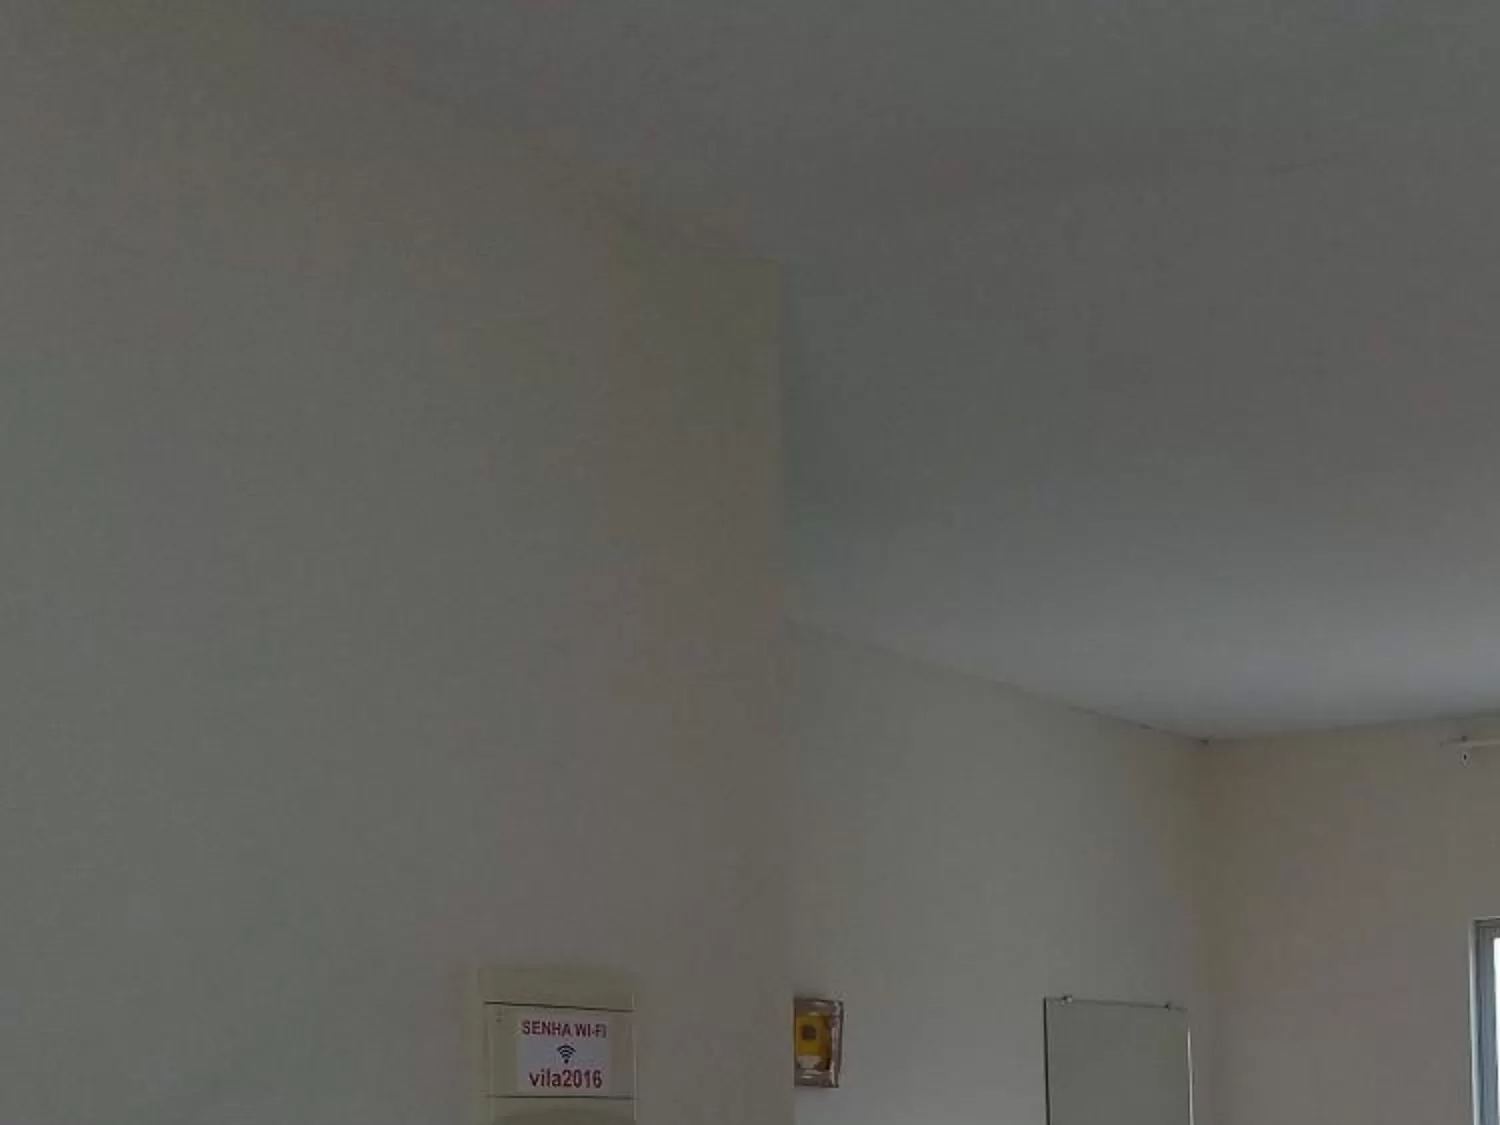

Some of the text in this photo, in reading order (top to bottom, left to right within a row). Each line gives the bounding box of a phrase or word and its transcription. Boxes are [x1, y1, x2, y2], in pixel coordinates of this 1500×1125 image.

[521, 1020, 607, 1038] SENHA WI-FI
[528, 1068, 603, 1088] vila2016
